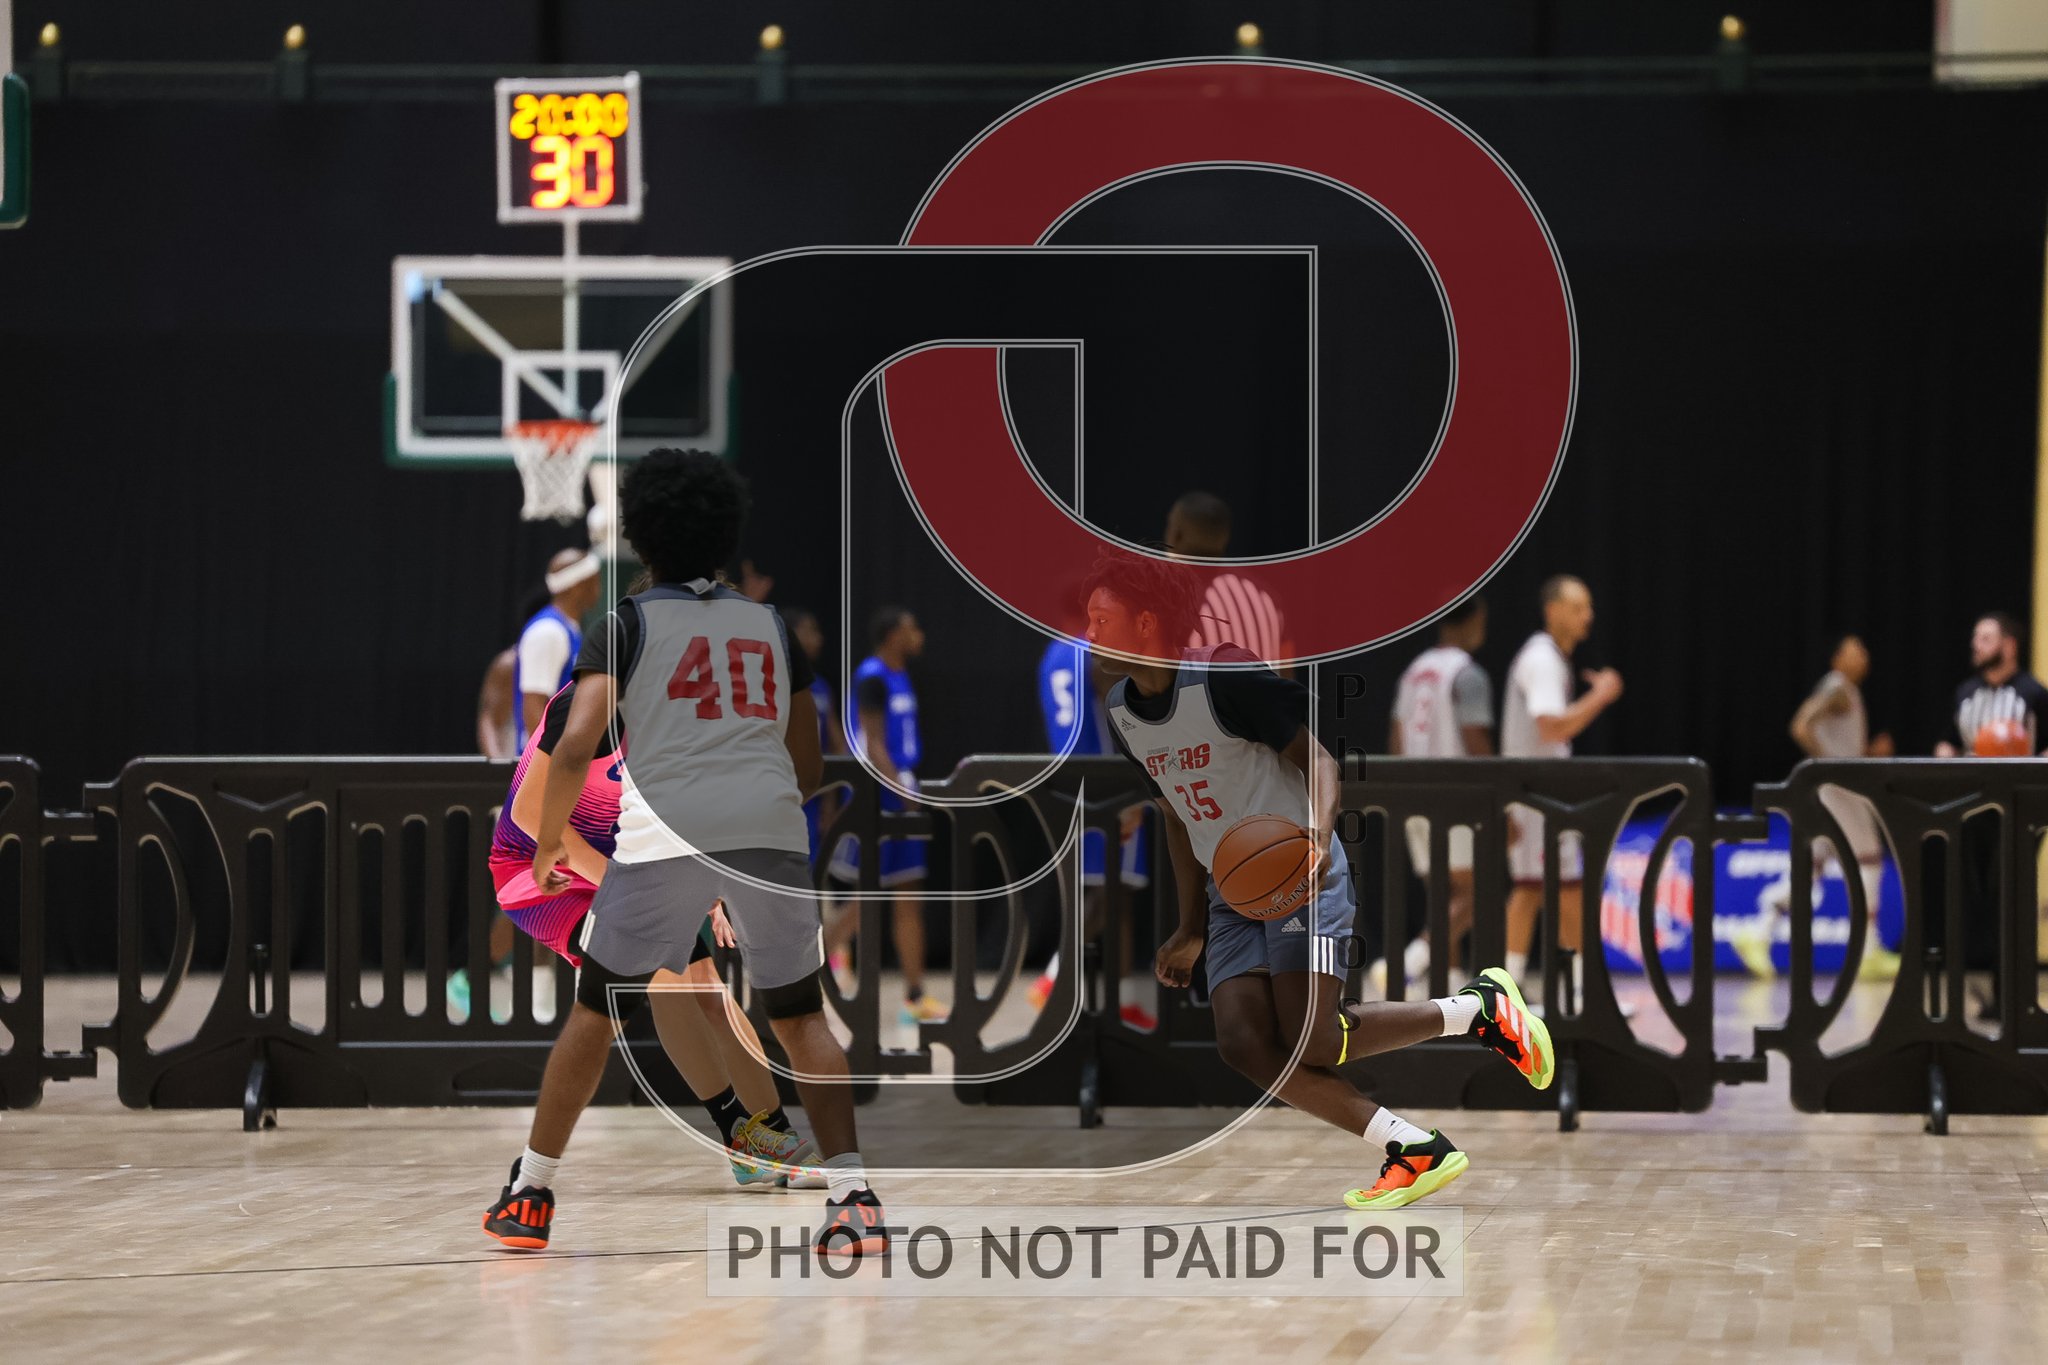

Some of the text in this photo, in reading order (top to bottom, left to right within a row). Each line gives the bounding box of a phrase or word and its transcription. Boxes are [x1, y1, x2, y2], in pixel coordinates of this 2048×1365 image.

[510, 93, 629, 139] 20:00
[530, 134, 614, 209] 30
[667, 636, 778, 721] 40
